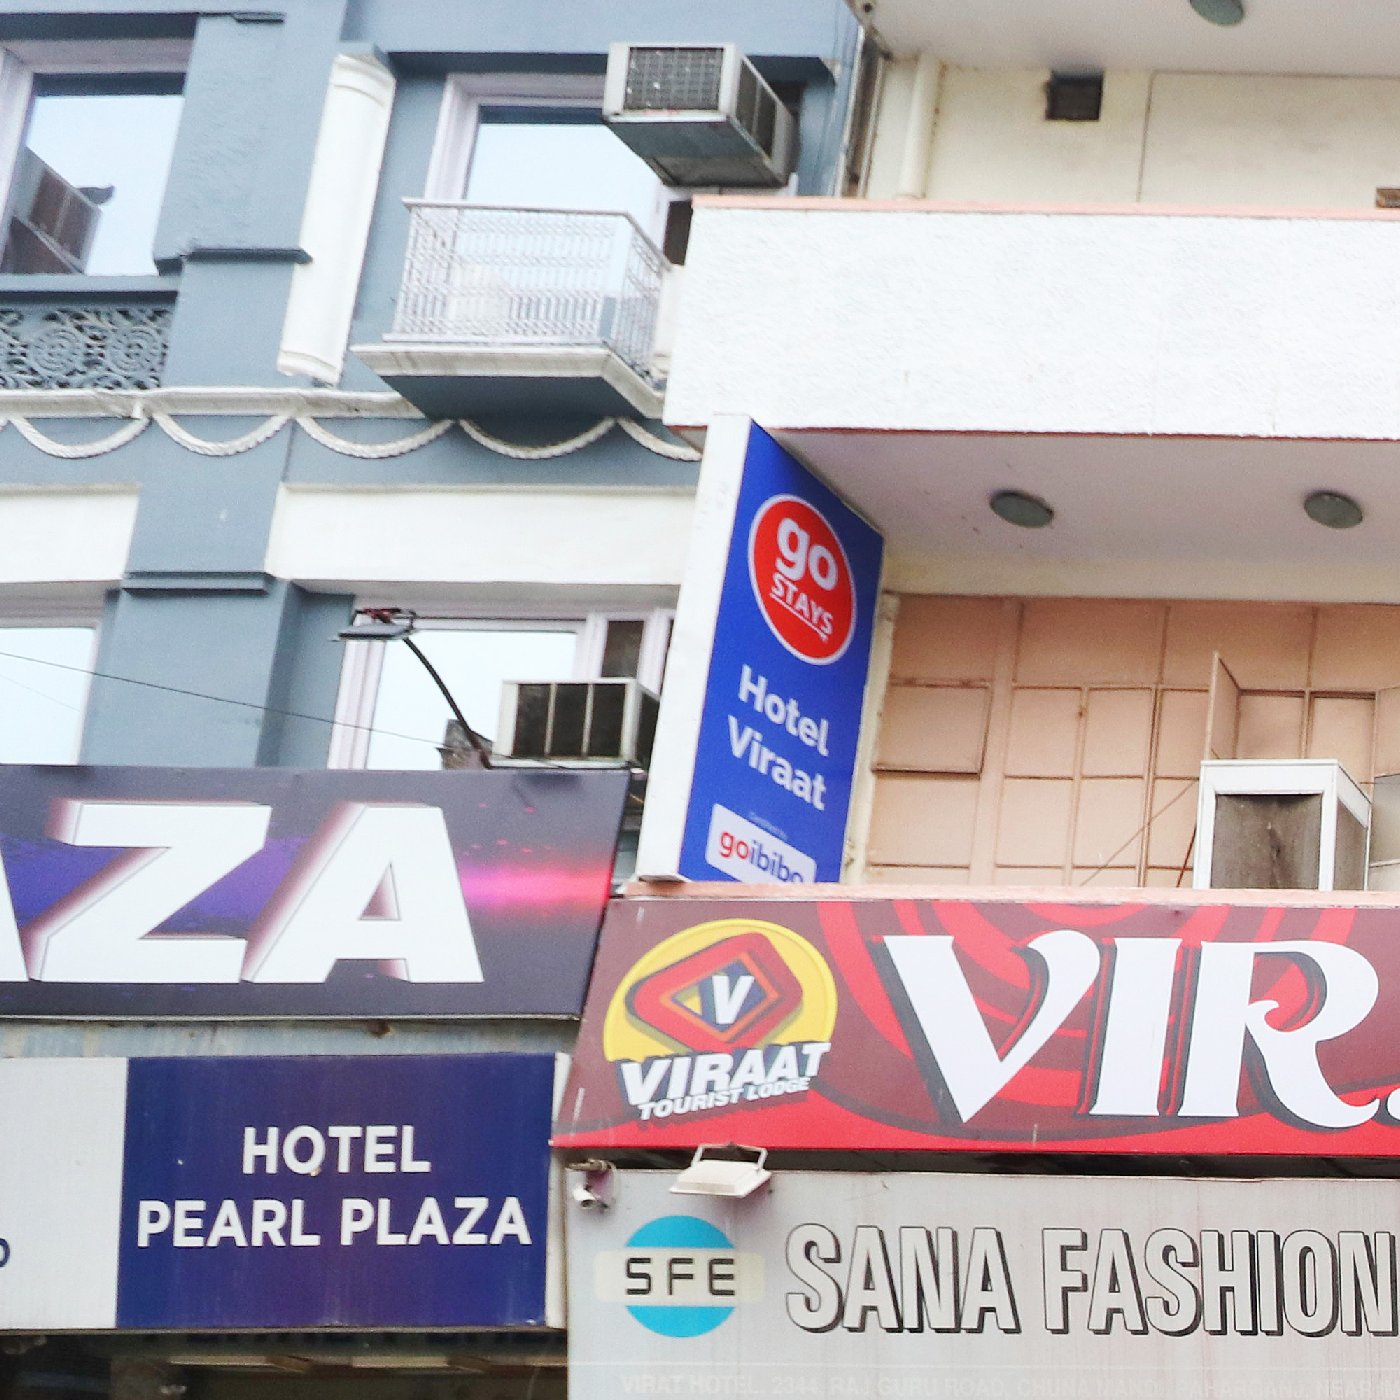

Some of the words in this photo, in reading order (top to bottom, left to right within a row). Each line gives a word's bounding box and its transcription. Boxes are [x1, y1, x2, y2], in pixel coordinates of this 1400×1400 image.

[775, 516, 839, 588] go
[770, 574, 834, 636] STAYS
[739, 663, 829, 758] Hotel
[727, 714, 827, 812] Viraat
[0, 801, 484, 983] ZA
[619, 1041, 832, 1106] VIRAAT
[637, 1086, 744, 1121] TOURIST
[746, 1075, 811, 1103] LODGE
[242, 1125, 432, 1176] HOTEL
[136, 1198, 321, 1248] PEARL
[340, 1197, 532, 1246] PLAZA
[785, 1222, 1022, 1335] SANA
[1041, 1227, 1398, 1338] FASHION
